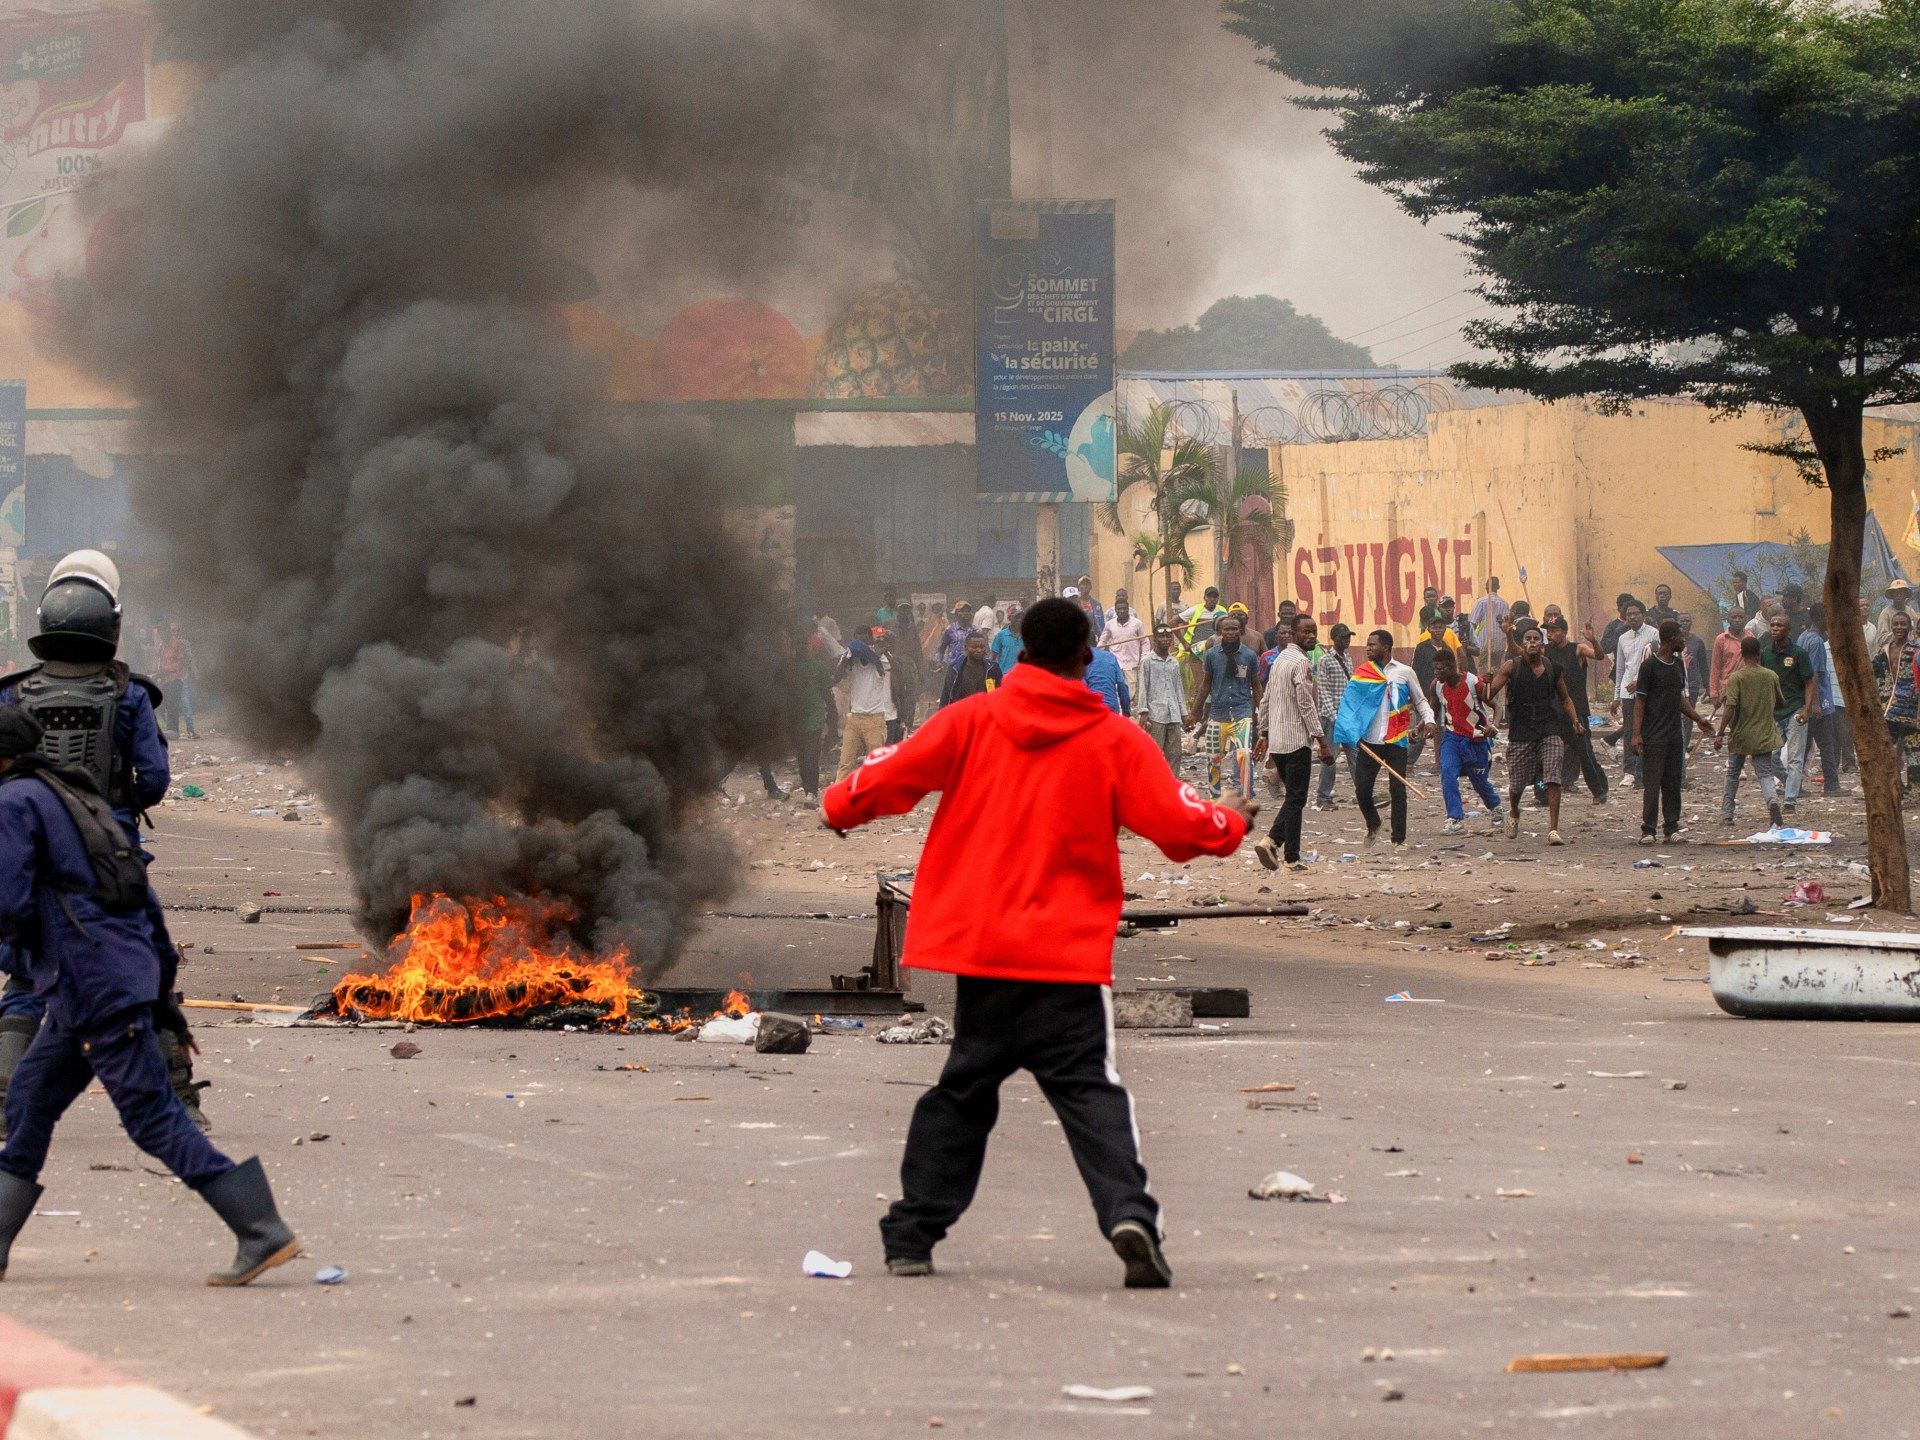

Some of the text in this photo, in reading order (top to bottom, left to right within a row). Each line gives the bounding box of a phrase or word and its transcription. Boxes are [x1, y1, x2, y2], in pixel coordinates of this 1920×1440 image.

[29, 98, 121, 154] nutry
[1027, 277, 1099, 293] SOMMET
[1043, 306, 1099, 323] CIRGL
[1027, 340, 1039, 352] la
[1041, 336, 1080, 357] paix
[1005, 352, 1099, 370] la sécurité
[994, 410, 1064, 422] 15 Nov. 2025
[1294, 523, 1473, 627] SÉVIGNÉ
